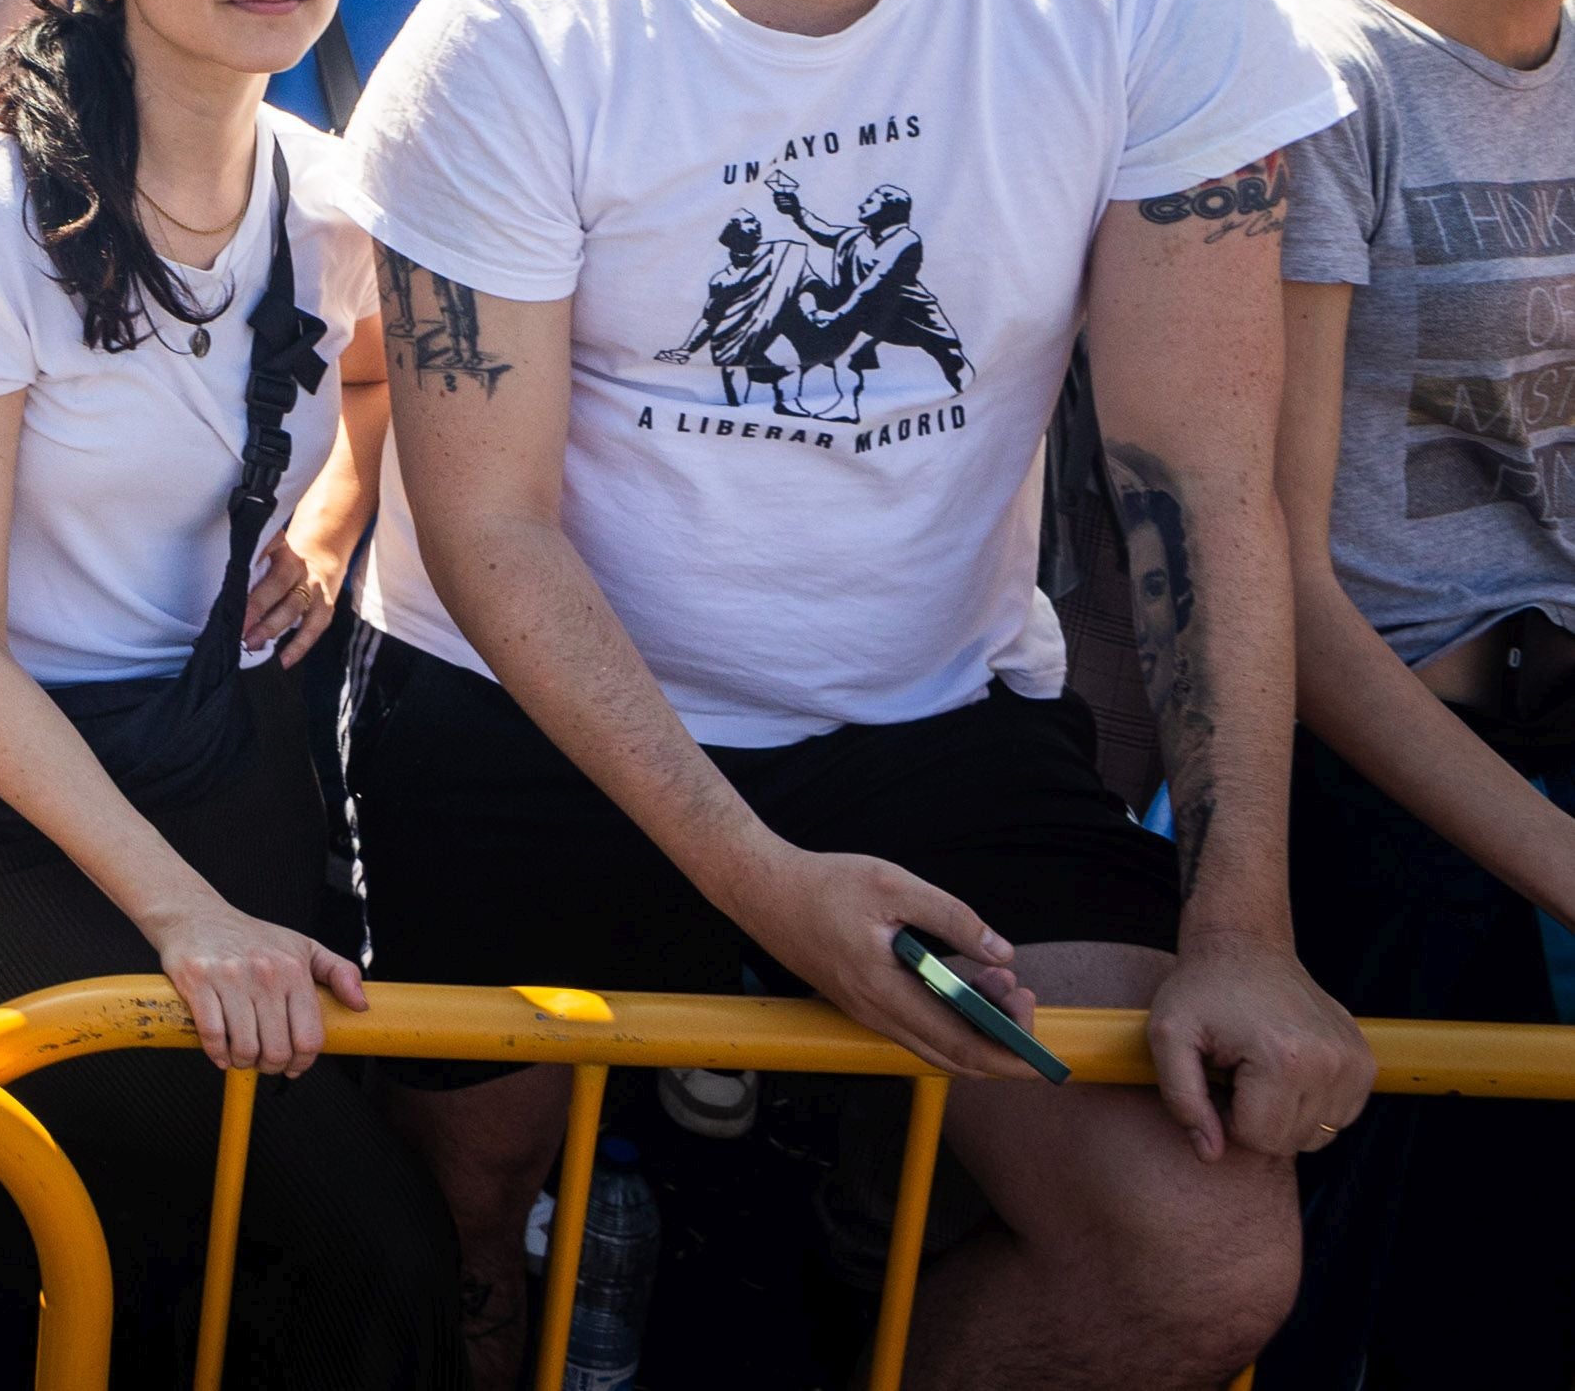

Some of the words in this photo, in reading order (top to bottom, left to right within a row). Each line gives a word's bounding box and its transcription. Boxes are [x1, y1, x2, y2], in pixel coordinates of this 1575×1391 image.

[723, 161, 760, 185] UN
[773, 131, 839, 164] AYO
[858, 115, 921, 146] MÁS
[637, 406, 653, 430] A
[677, 413, 835, 450] LIBERAR
[854, 404, 966, 454] MADRID
